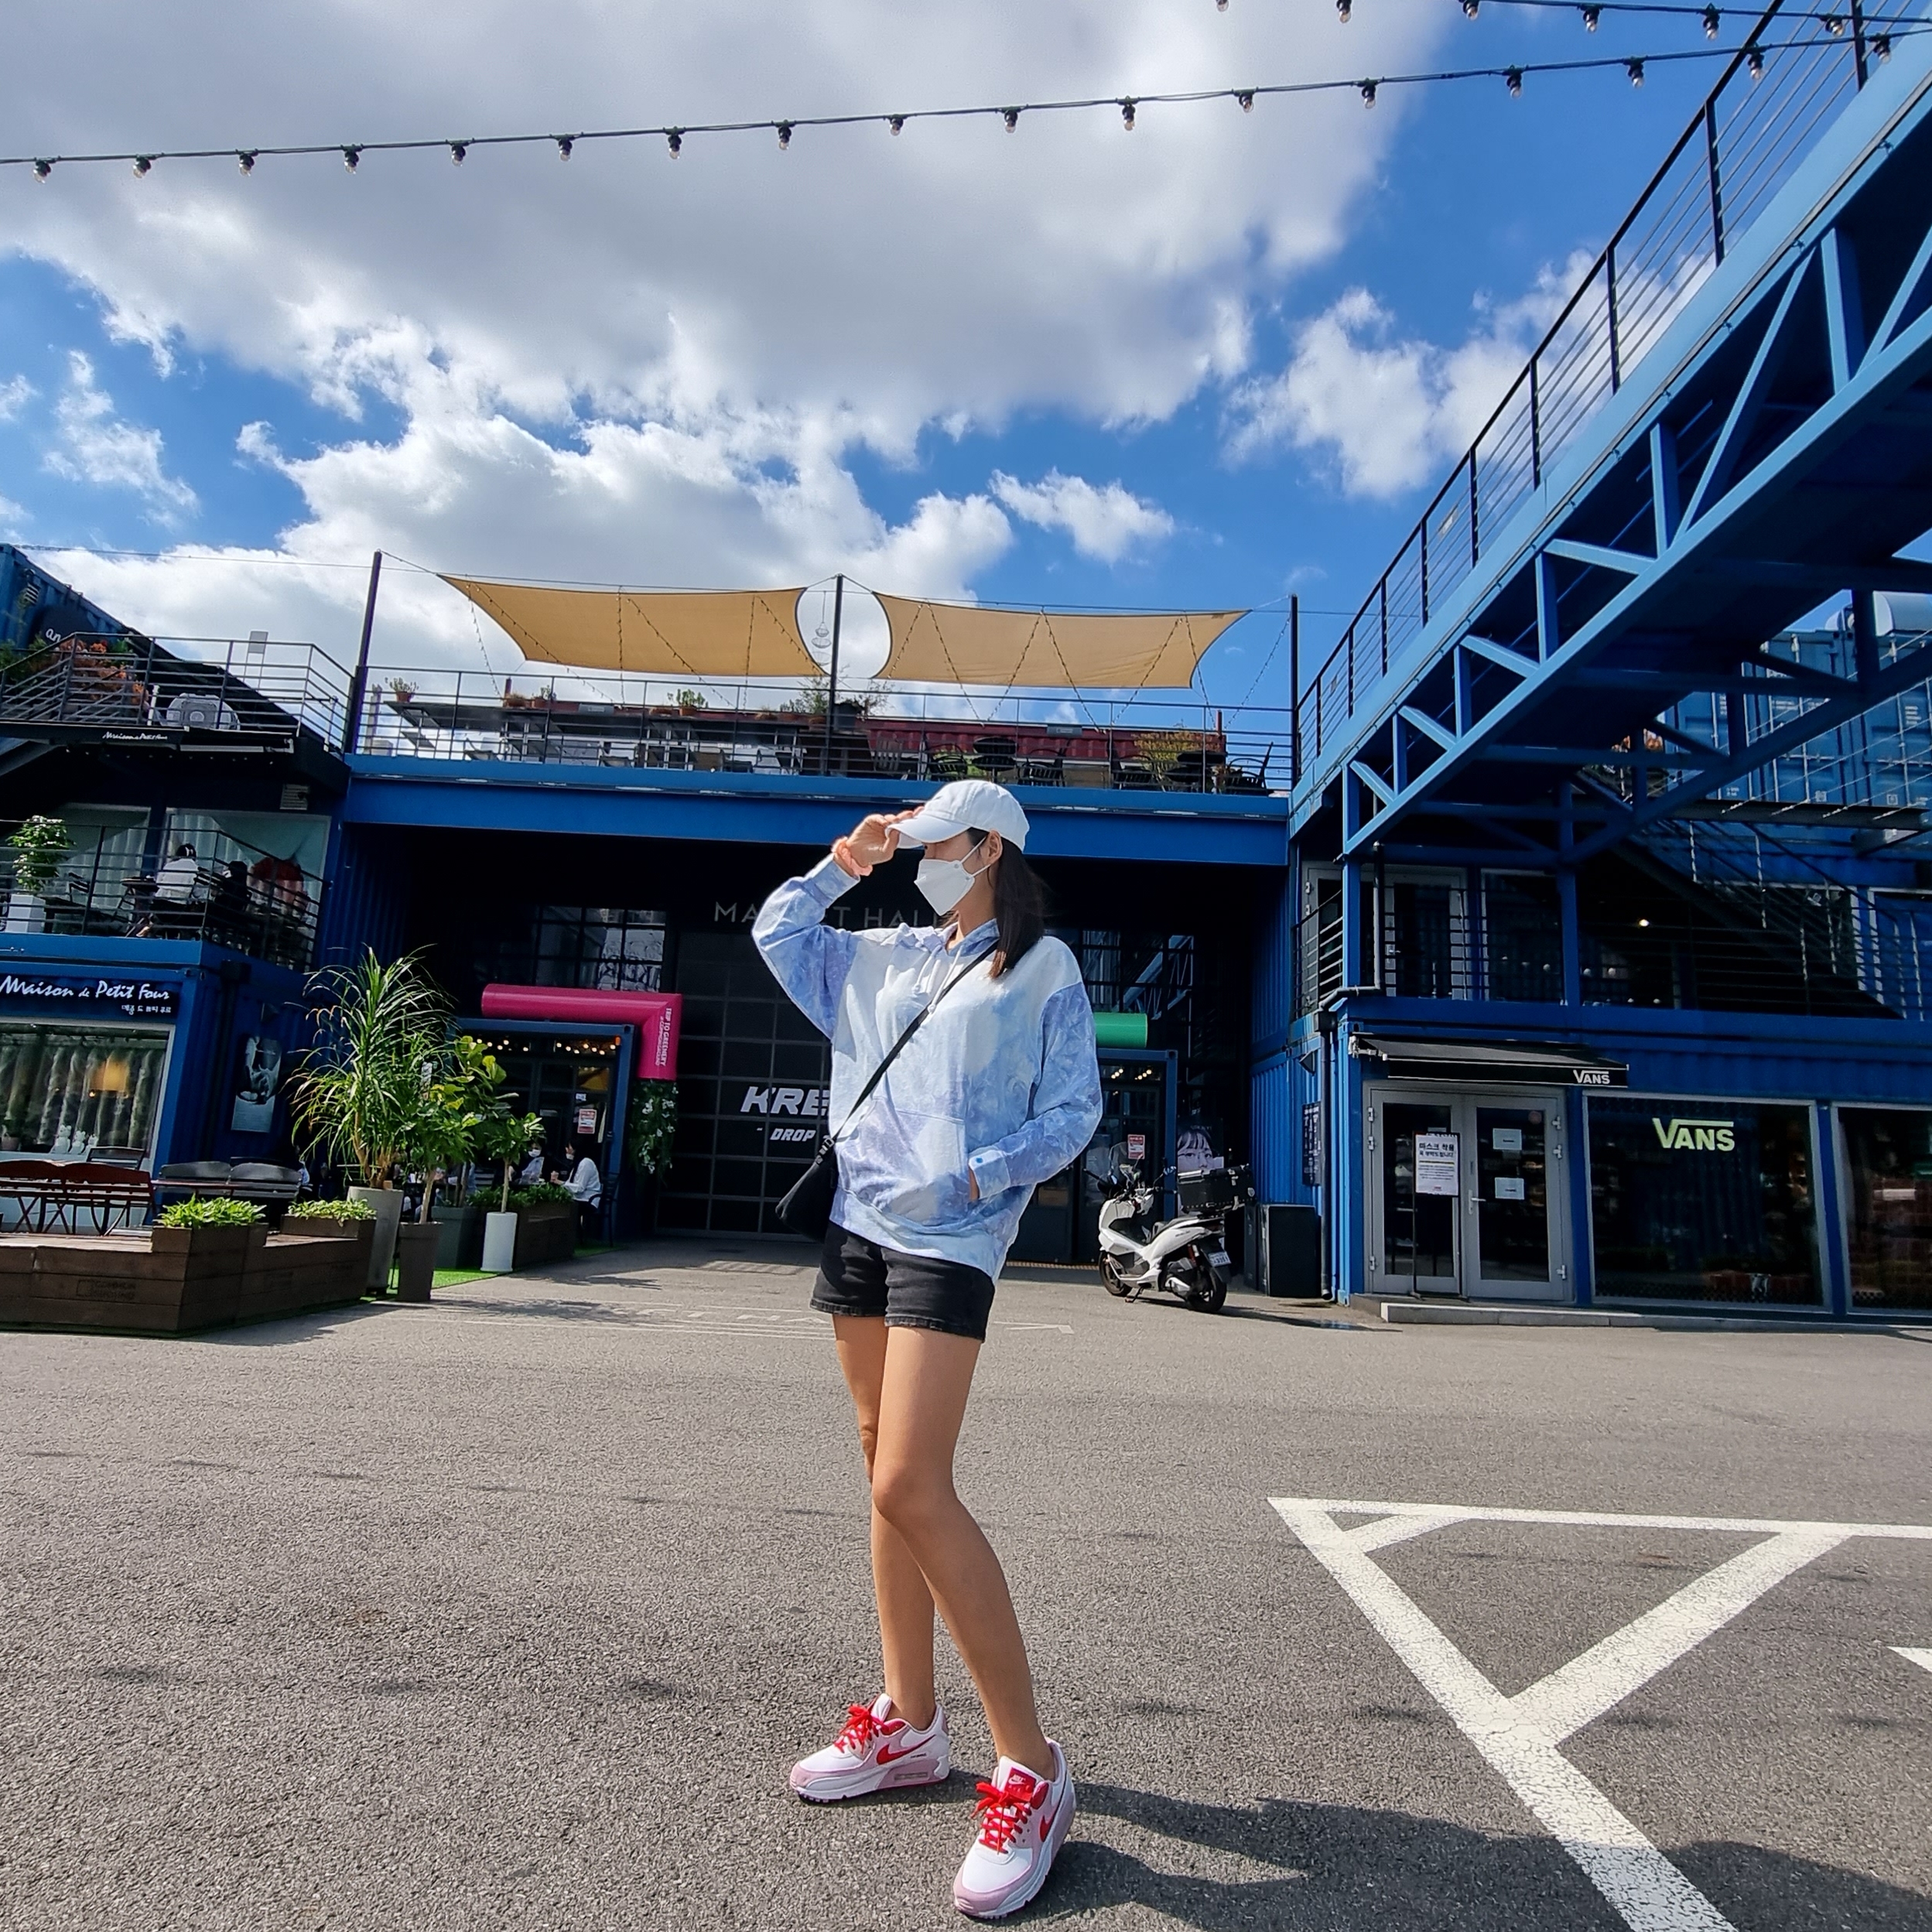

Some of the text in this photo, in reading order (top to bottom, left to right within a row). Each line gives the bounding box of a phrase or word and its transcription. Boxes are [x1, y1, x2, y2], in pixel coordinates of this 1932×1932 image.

[713, 901, 851, 928] MAT
[0, 975, 74, 997] Maison
[95, 980, 135, 999] Petit
[138, 983, 170, 1000] Four
[770, 1128, 816, 1141] DROP
